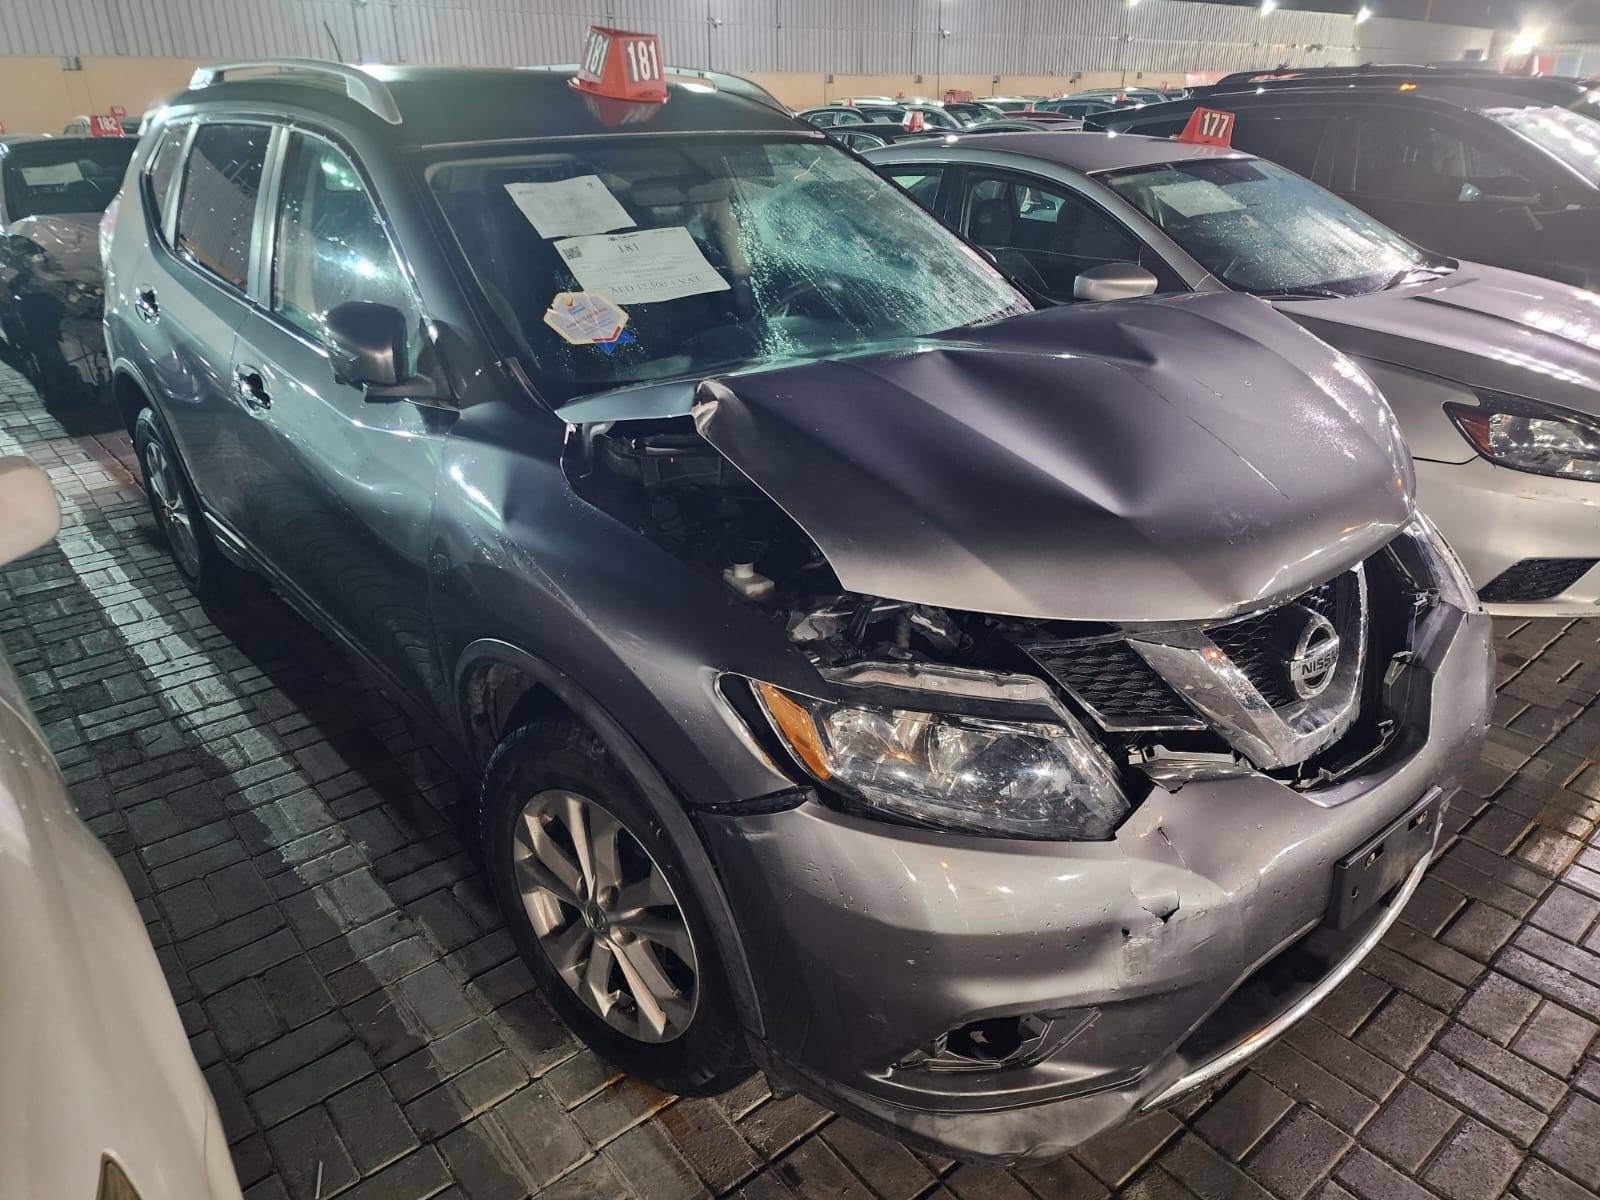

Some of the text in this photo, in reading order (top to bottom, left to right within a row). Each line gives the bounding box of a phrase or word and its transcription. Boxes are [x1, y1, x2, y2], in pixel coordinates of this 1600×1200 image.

[585, 32, 610, 77] 181
[627, 40, 660, 82] 181
[96, 115, 119, 132] 182
[1202, 112, 1230, 138] 177
[616, 242, 640, 254] 181
[1302, 650, 1337, 676] NISSA
